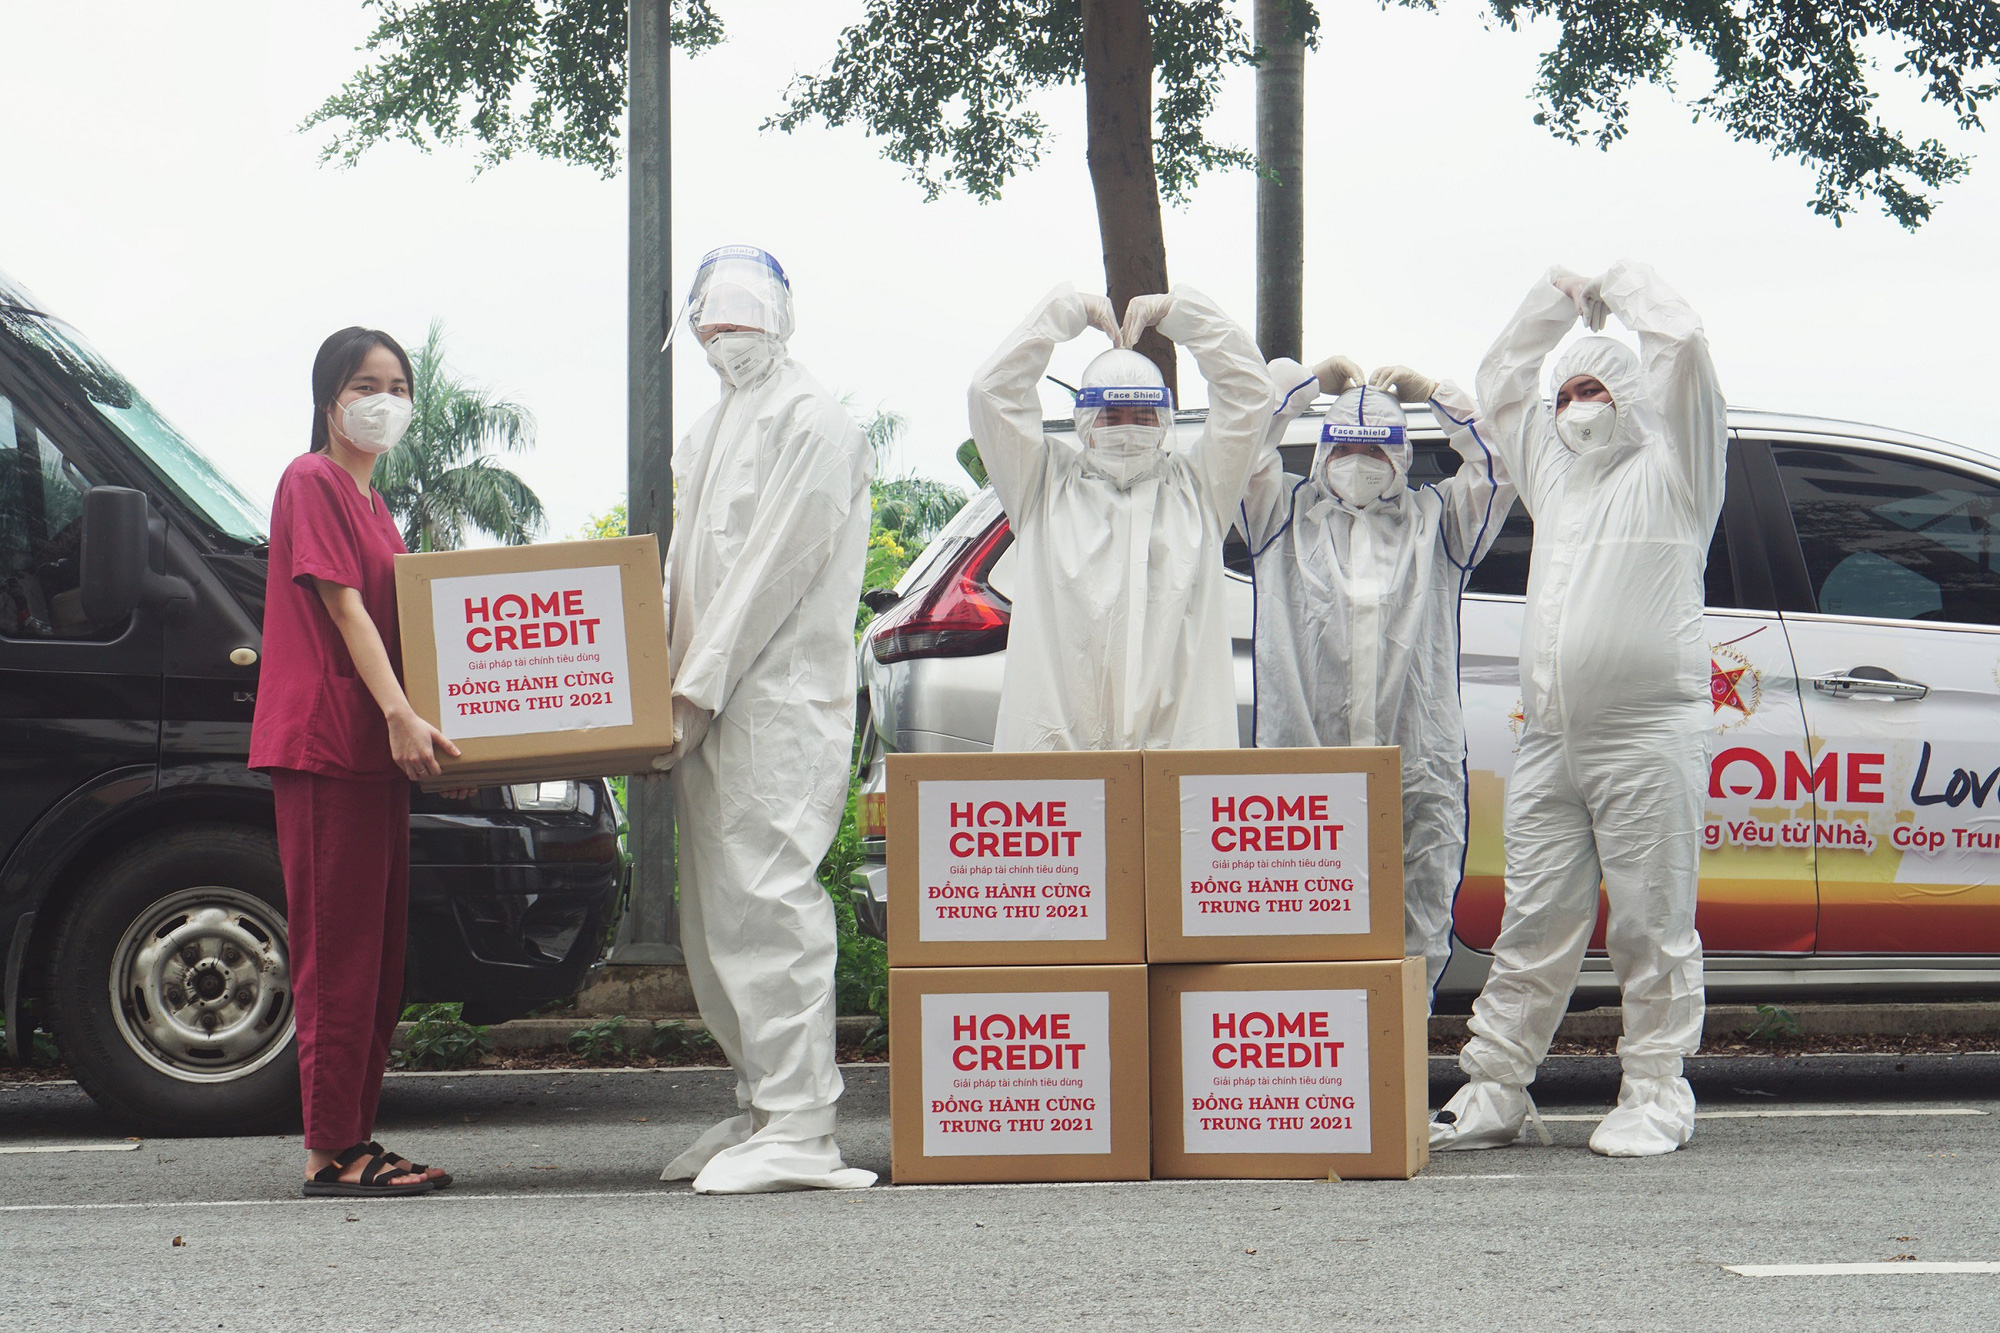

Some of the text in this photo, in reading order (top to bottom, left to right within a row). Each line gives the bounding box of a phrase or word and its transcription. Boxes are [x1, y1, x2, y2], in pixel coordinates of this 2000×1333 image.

[722, 247, 755, 255] Shield
[1108, 391, 1130, 399] Face
[1133, 391, 1160, 399] Shield
[1333, 427, 1354, 435] Face
[1357, 428, 1386, 436] shield
[464, 589, 584, 624] HOME
[466, 618, 600, 653] CREDIT
[469, 653, 600, 671] Giải pháp tài chính tiêu dùng
[448, 671, 614, 697] ĐỒNG HÀNH CÙNG
[457, 692, 613, 715] TRUNG THU 2021
[1708, 741, 2000, 808] OME Lov
[950, 801, 1067, 828] HOME
[1212, 795, 1329, 822] HOME
[949, 831, 1082, 858] CREDIT
[1211, 824, 1344, 852] CREDIT
[1727, 821, 1774, 842] Yêu
[1782, 822, 1811, 843] từ
[1816, 823, 1873, 849] Nhà,
[1893, 825, 1946, 851] Góp
[949, 865, 1079, 875] Giải pháp tài chính tiêu dùng
[1212, 859, 1341, 870] Giải pháp tài chính tiêu dùng
[928, 881, 1091, 899] ĐỒNG HÀNH CÙNG
[1190, 876, 1354, 893] ĐỒNG HÀNH CÙNG
[936, 904, 1088, 919] TRUNG THU 2021
[1198, 899, 1351, 914] TRUNG THU 2021
[953, 1013, 1071, 1041] HOME
[1213, 1011, 1329, 1039] HOME
[953, 1043, 1086, 1071] CREDIT
[1212, 1041, 1345, 1069] CREDIT
[953, 1077, 1083, 1089] Giải pháp tài chính tiêu dùng
[1213, 1076, 1342, 1087] Giải pháp tài chính tiêu dùng
[932, 1095, 1096, 1113] ĐỒNG HÀNH CÙNG
[1193, 1093, 1355, 1111] ĐỒNG HÀNH CÙNG
[939, 1118, 1093, 1133] TRUNG THU 2021
[1200, 1116, 1352, 1130] TRUNG THU 2021
